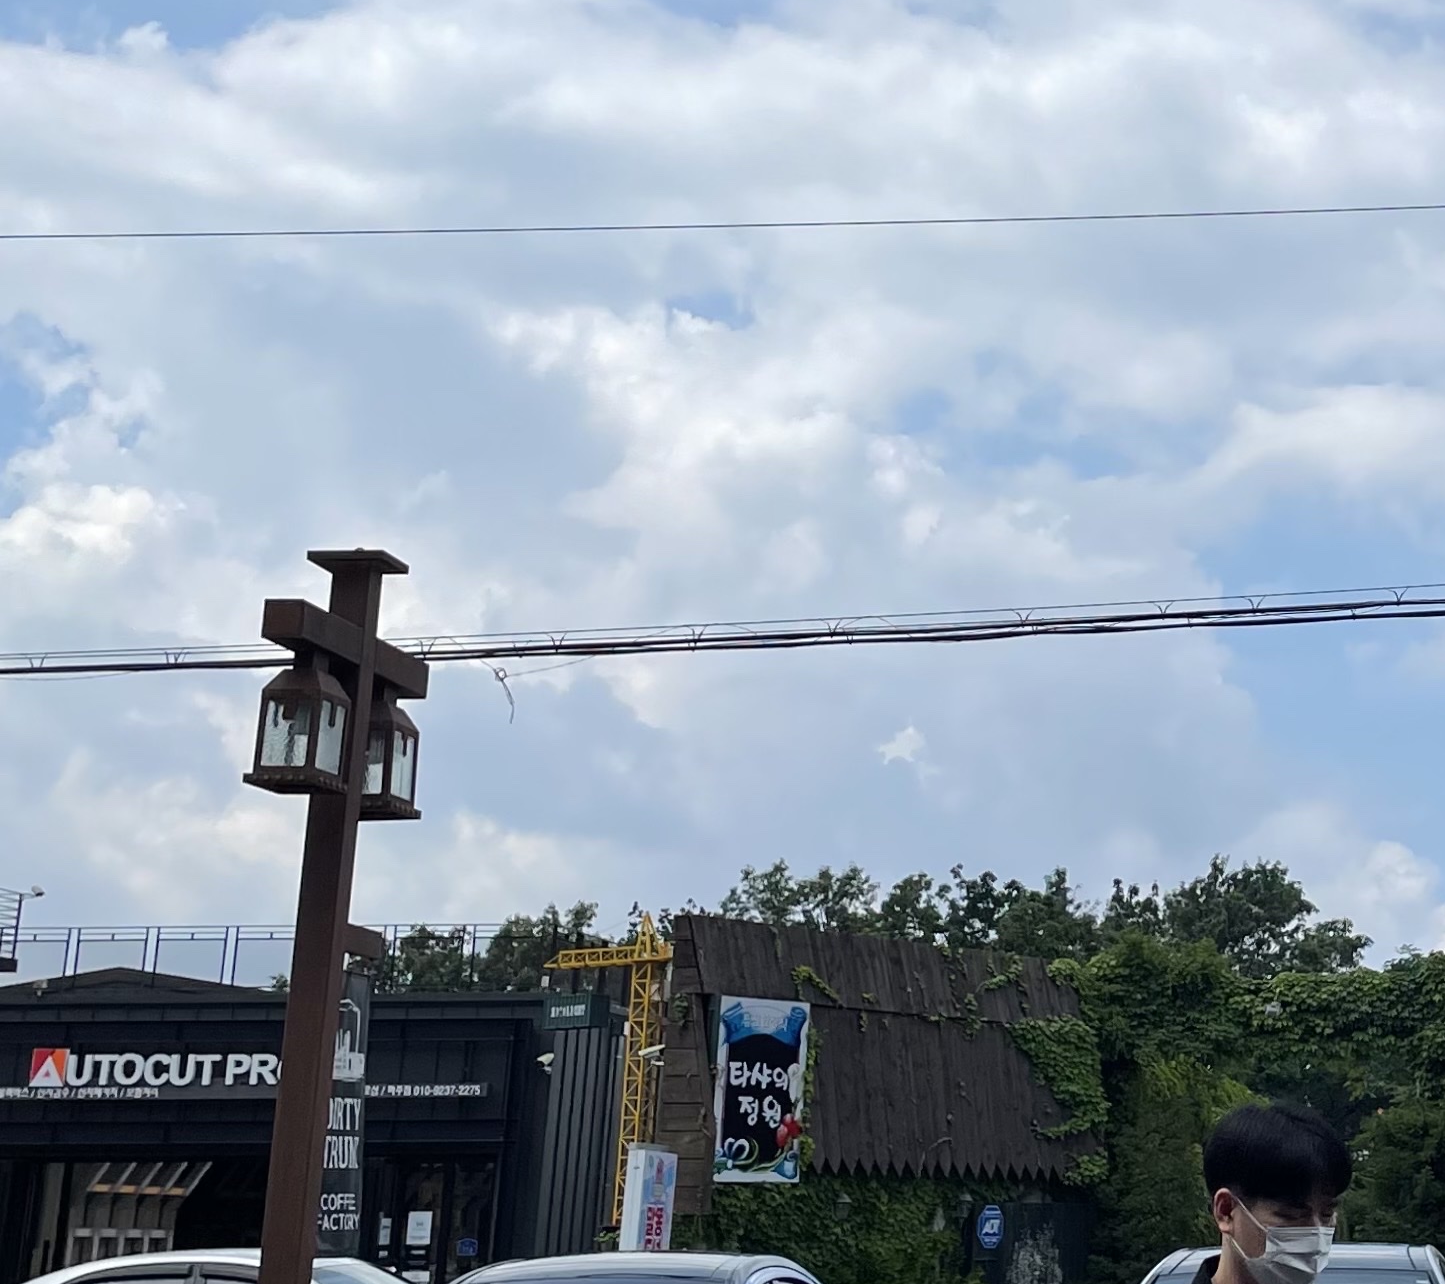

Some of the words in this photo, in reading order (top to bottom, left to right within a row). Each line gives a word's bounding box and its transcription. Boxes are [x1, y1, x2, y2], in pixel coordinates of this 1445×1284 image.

[28, 1048, 223, 1087] AUTOCUT
[224, 1053, 282, 1086] PR
[729, 1061, 789, 1091] 타샤의
[738, 1095, 782, 1129] 정원
